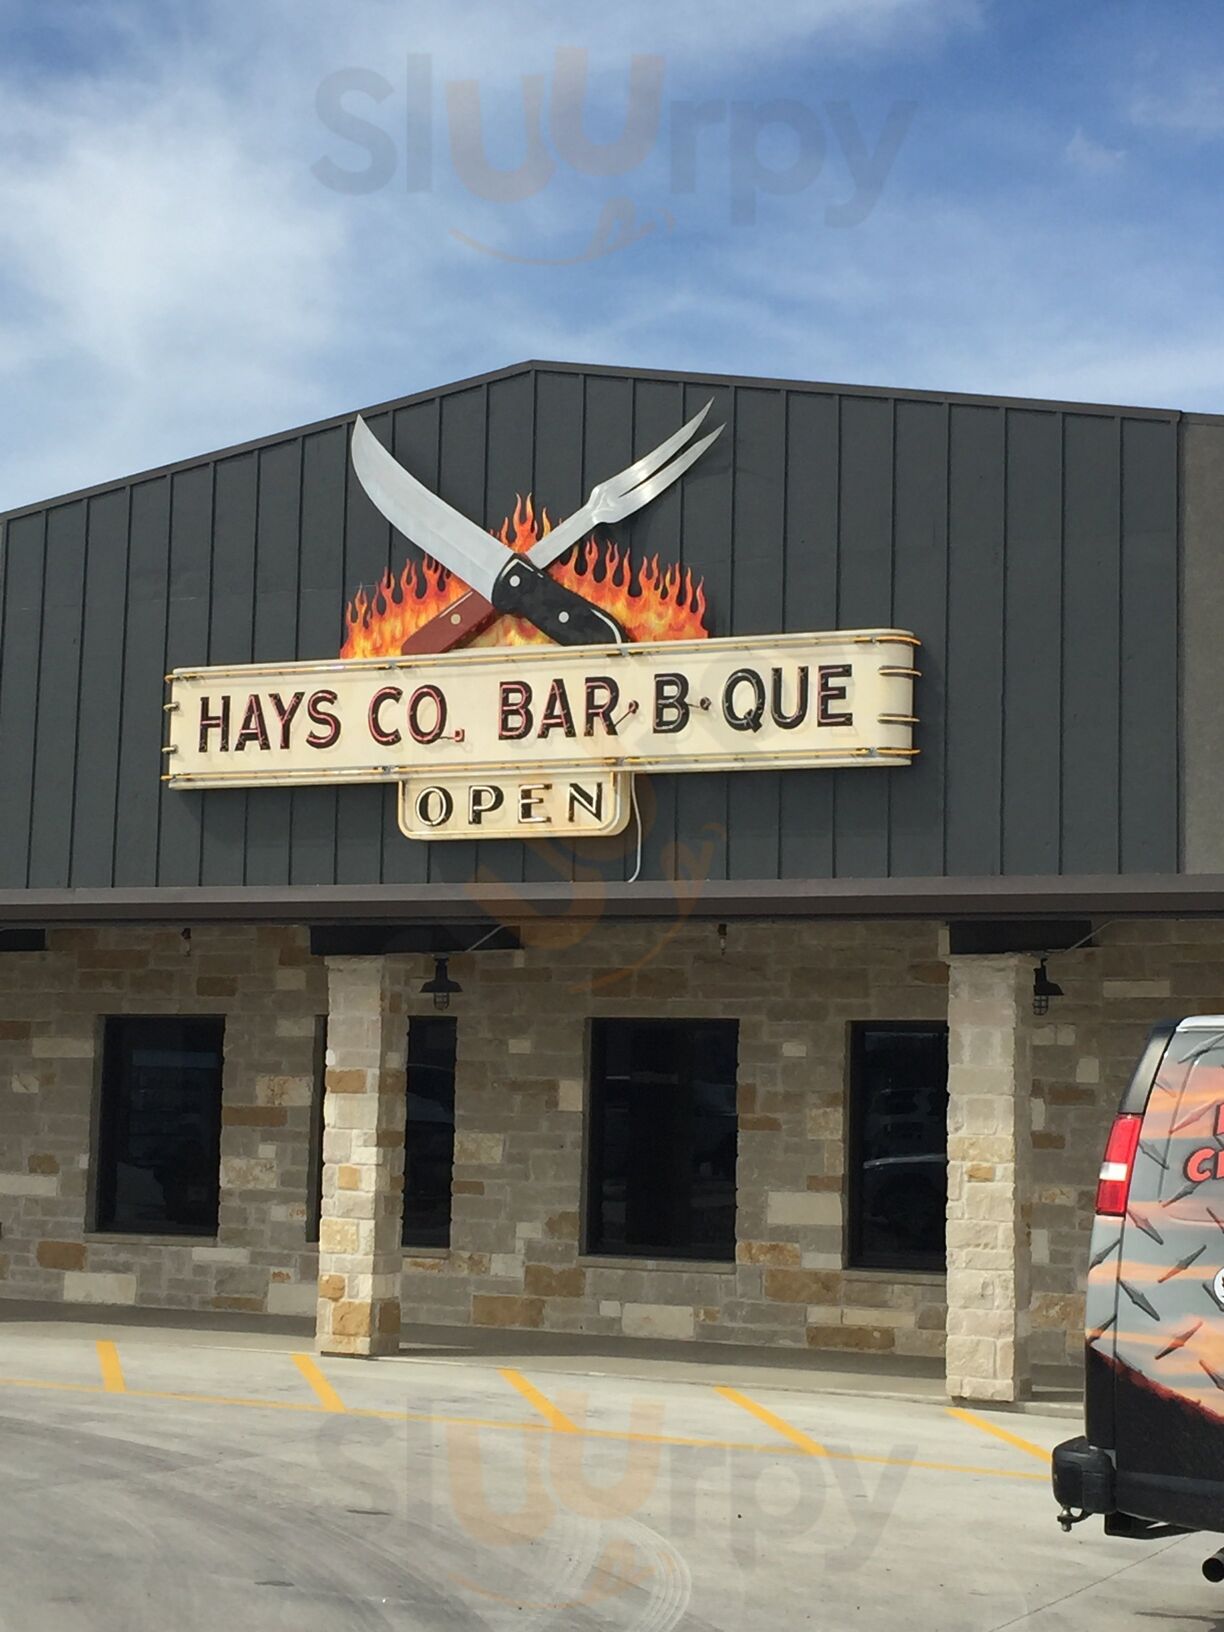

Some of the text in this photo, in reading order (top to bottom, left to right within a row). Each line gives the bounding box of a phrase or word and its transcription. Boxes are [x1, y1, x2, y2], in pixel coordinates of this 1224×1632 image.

[199, 689, 342, 753] HAYS
[367, 684, 465, 746] CO.
[415, 782, 604, 827] OPEN
